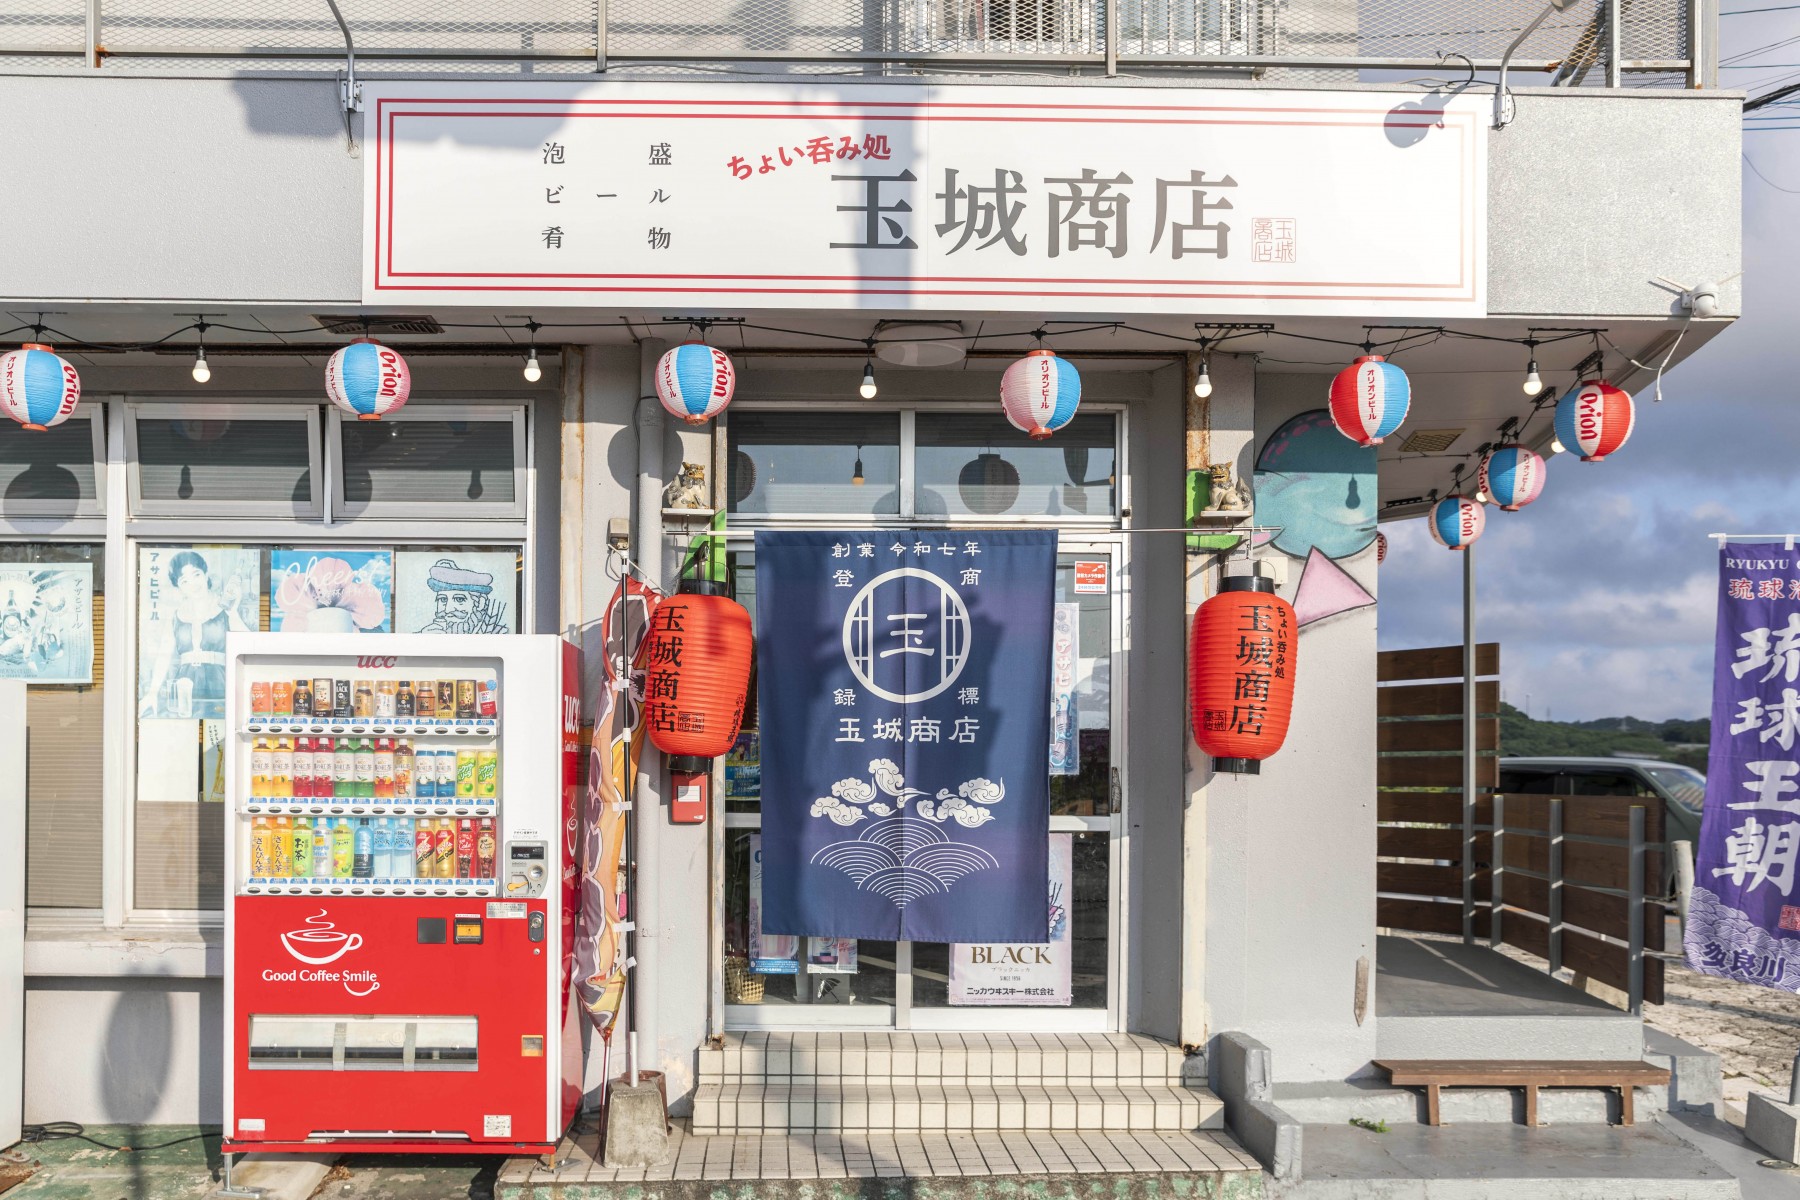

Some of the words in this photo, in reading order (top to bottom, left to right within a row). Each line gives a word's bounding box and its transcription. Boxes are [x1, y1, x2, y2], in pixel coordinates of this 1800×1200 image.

[542, 142, 672, 166] 泡盛
[727, 133, 891, 180] ちょい呑み処
[545, 186, 671, 205] ビール
[829, 167, 1238, 260] 玉城商店
[6, 356, 18, 406] オリオンビール
[60, 365, 80, 415] Orion
[379, 351, 402, 397] Orion
[711, 349, 732, 398] Orion
[1040, 359, 1050, 410] オリオンビール
[1366, 369, 1378, 421] オリオンビール
[1579, 392, 1603, 441] Orion
[1460, 503, 1477, 537] Orion
[831, 542, 876, 558] 創業
[889, 541, 982, 557] 令和七年
[1725, 557, 1790, 570] RYUKYU
[150, 552, 160, 621] アサヒビール
[832, 569, 854, 587] 登
[960, 568, 982, 586] 商
[71, 577, 84, 630] アサヒビール
[879, 613, 935, 659] 玉
[1274, 605, 1288, 679] ちょい呑み処
[651, 605, 689, 733] 玉城商店
[1228, 604, 1274, 736] 玉城商店
[833, 688, 856, 706] 録
[958, 687, 980, 705] 標
[834, 716, 981, 744] 玉城商店
[1711, 612, 1800, 897] 琉球王朝
[294, 837, 306, 861] お茶
[261, 969, 297, 982] Good
[299, 969, 340, 982] Coffee
[342, 970, 377, 982] Smile
[971, 946, 1052, 965] BLACK
[1701, 941, 1786, 982] 多良川
[966, 987, 1055, 996] ニッカウヰスキー株式会社
